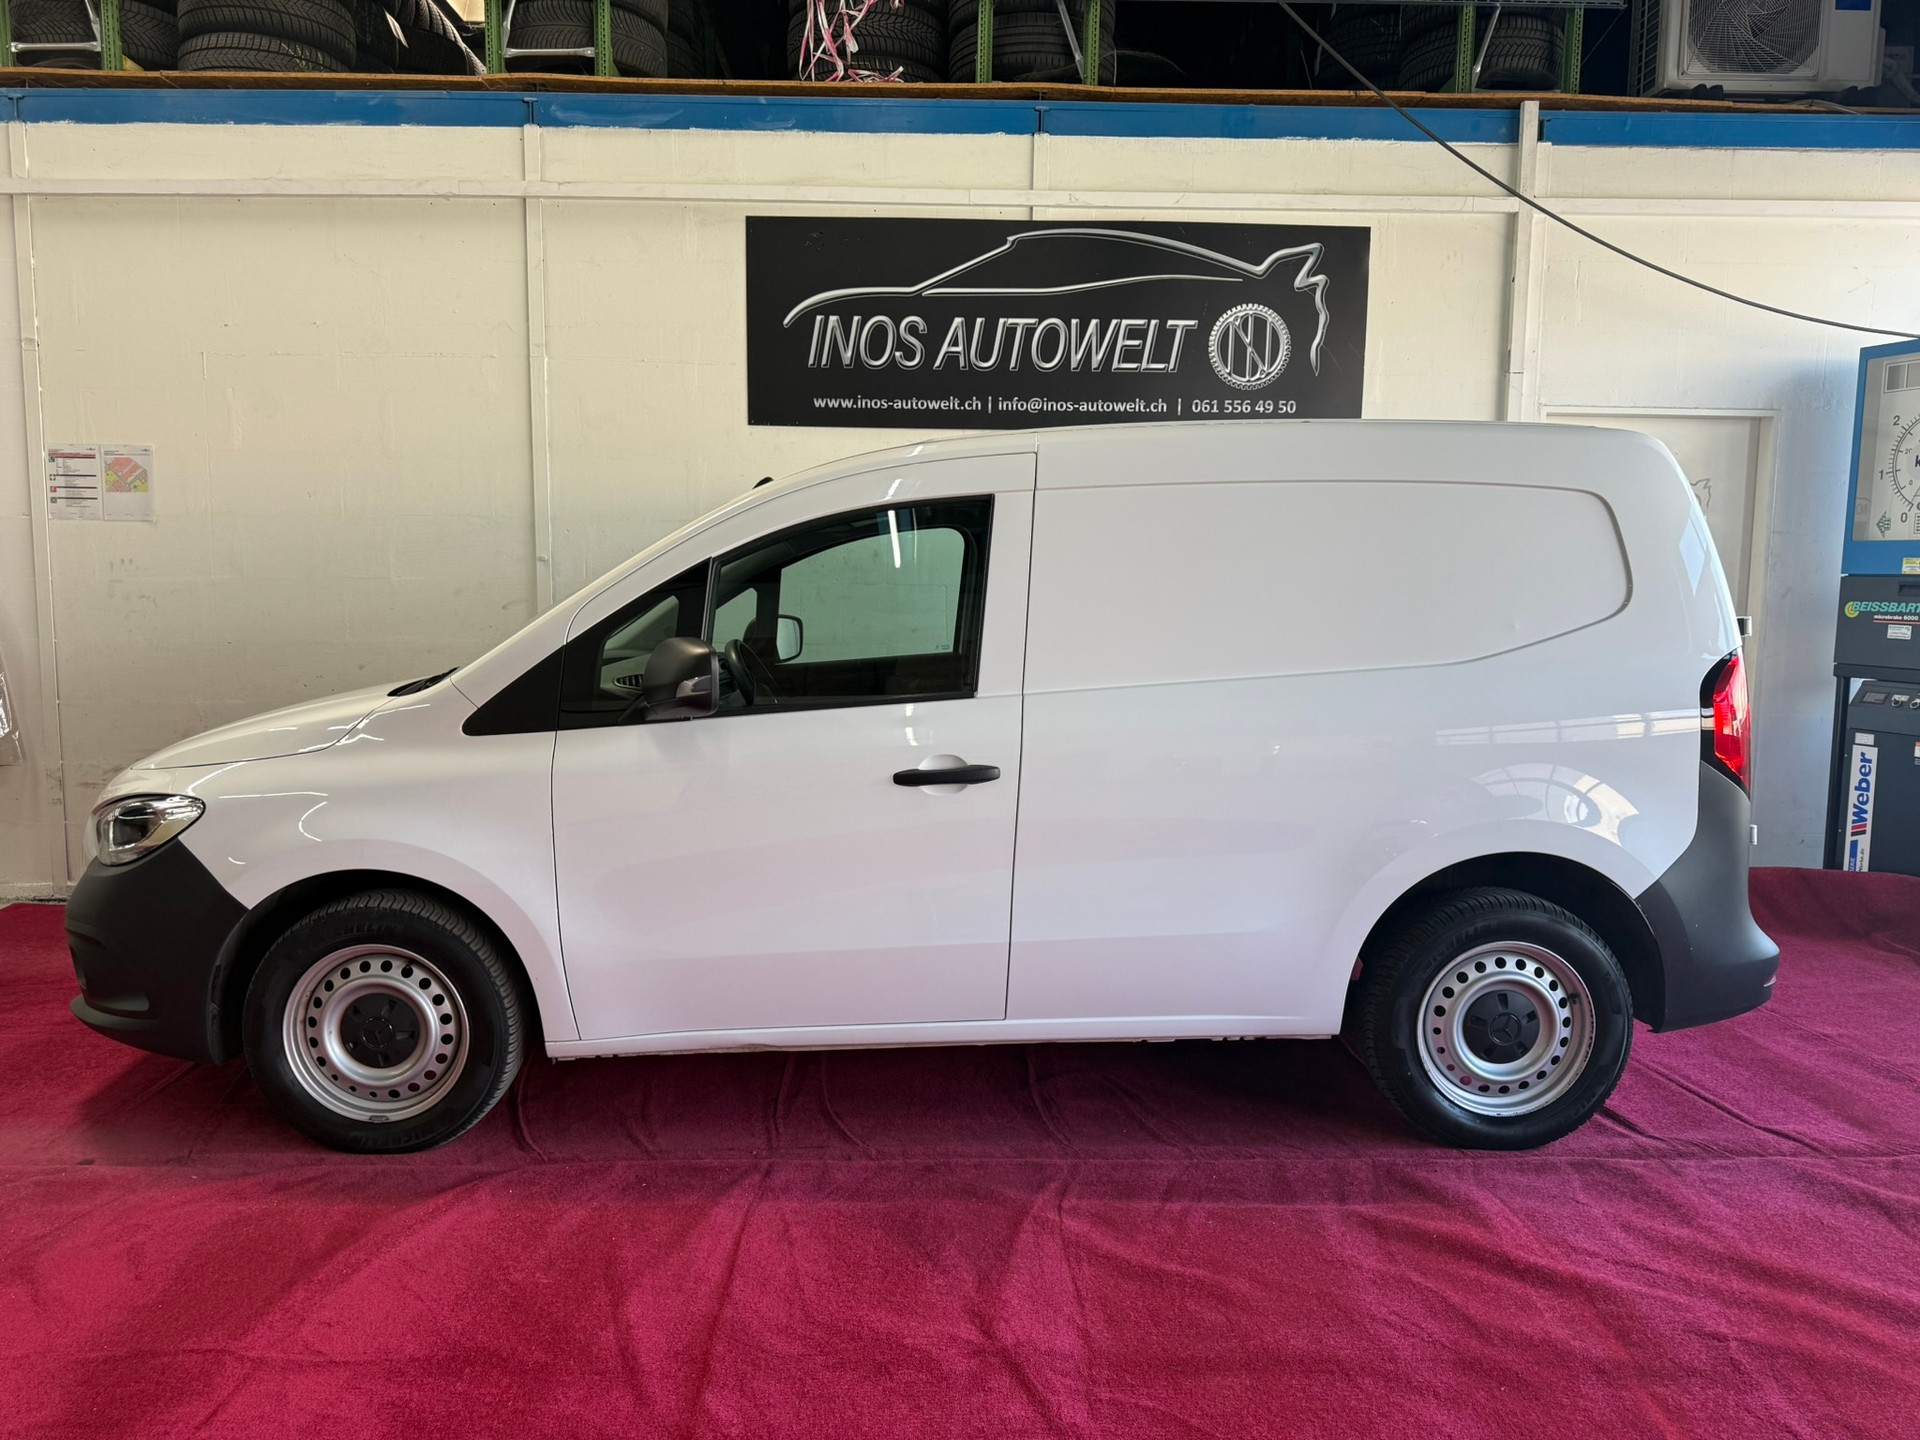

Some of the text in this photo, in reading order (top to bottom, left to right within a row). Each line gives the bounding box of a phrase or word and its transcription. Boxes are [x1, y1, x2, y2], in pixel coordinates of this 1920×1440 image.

[808, 315, 1198, 373] INOS AUTOWELT
[813, 395, 981, 411] www.inos-autowelt.ch
[998, 397, 1167, 413] info@inos-autowelt.ch
[1192, 399, 1219, 413] 061
[1224, 400, 1251, 413] 556
[1255, 400, 1274, 413] 49
[1278, 400, 1297, 414] 50
[1893, 415, 1900, 426] 2
[1878, 469, 1884, 480] 1
[1900, 512, 1908, 523] 0
[1851, 751, 1873, 824] Weber
